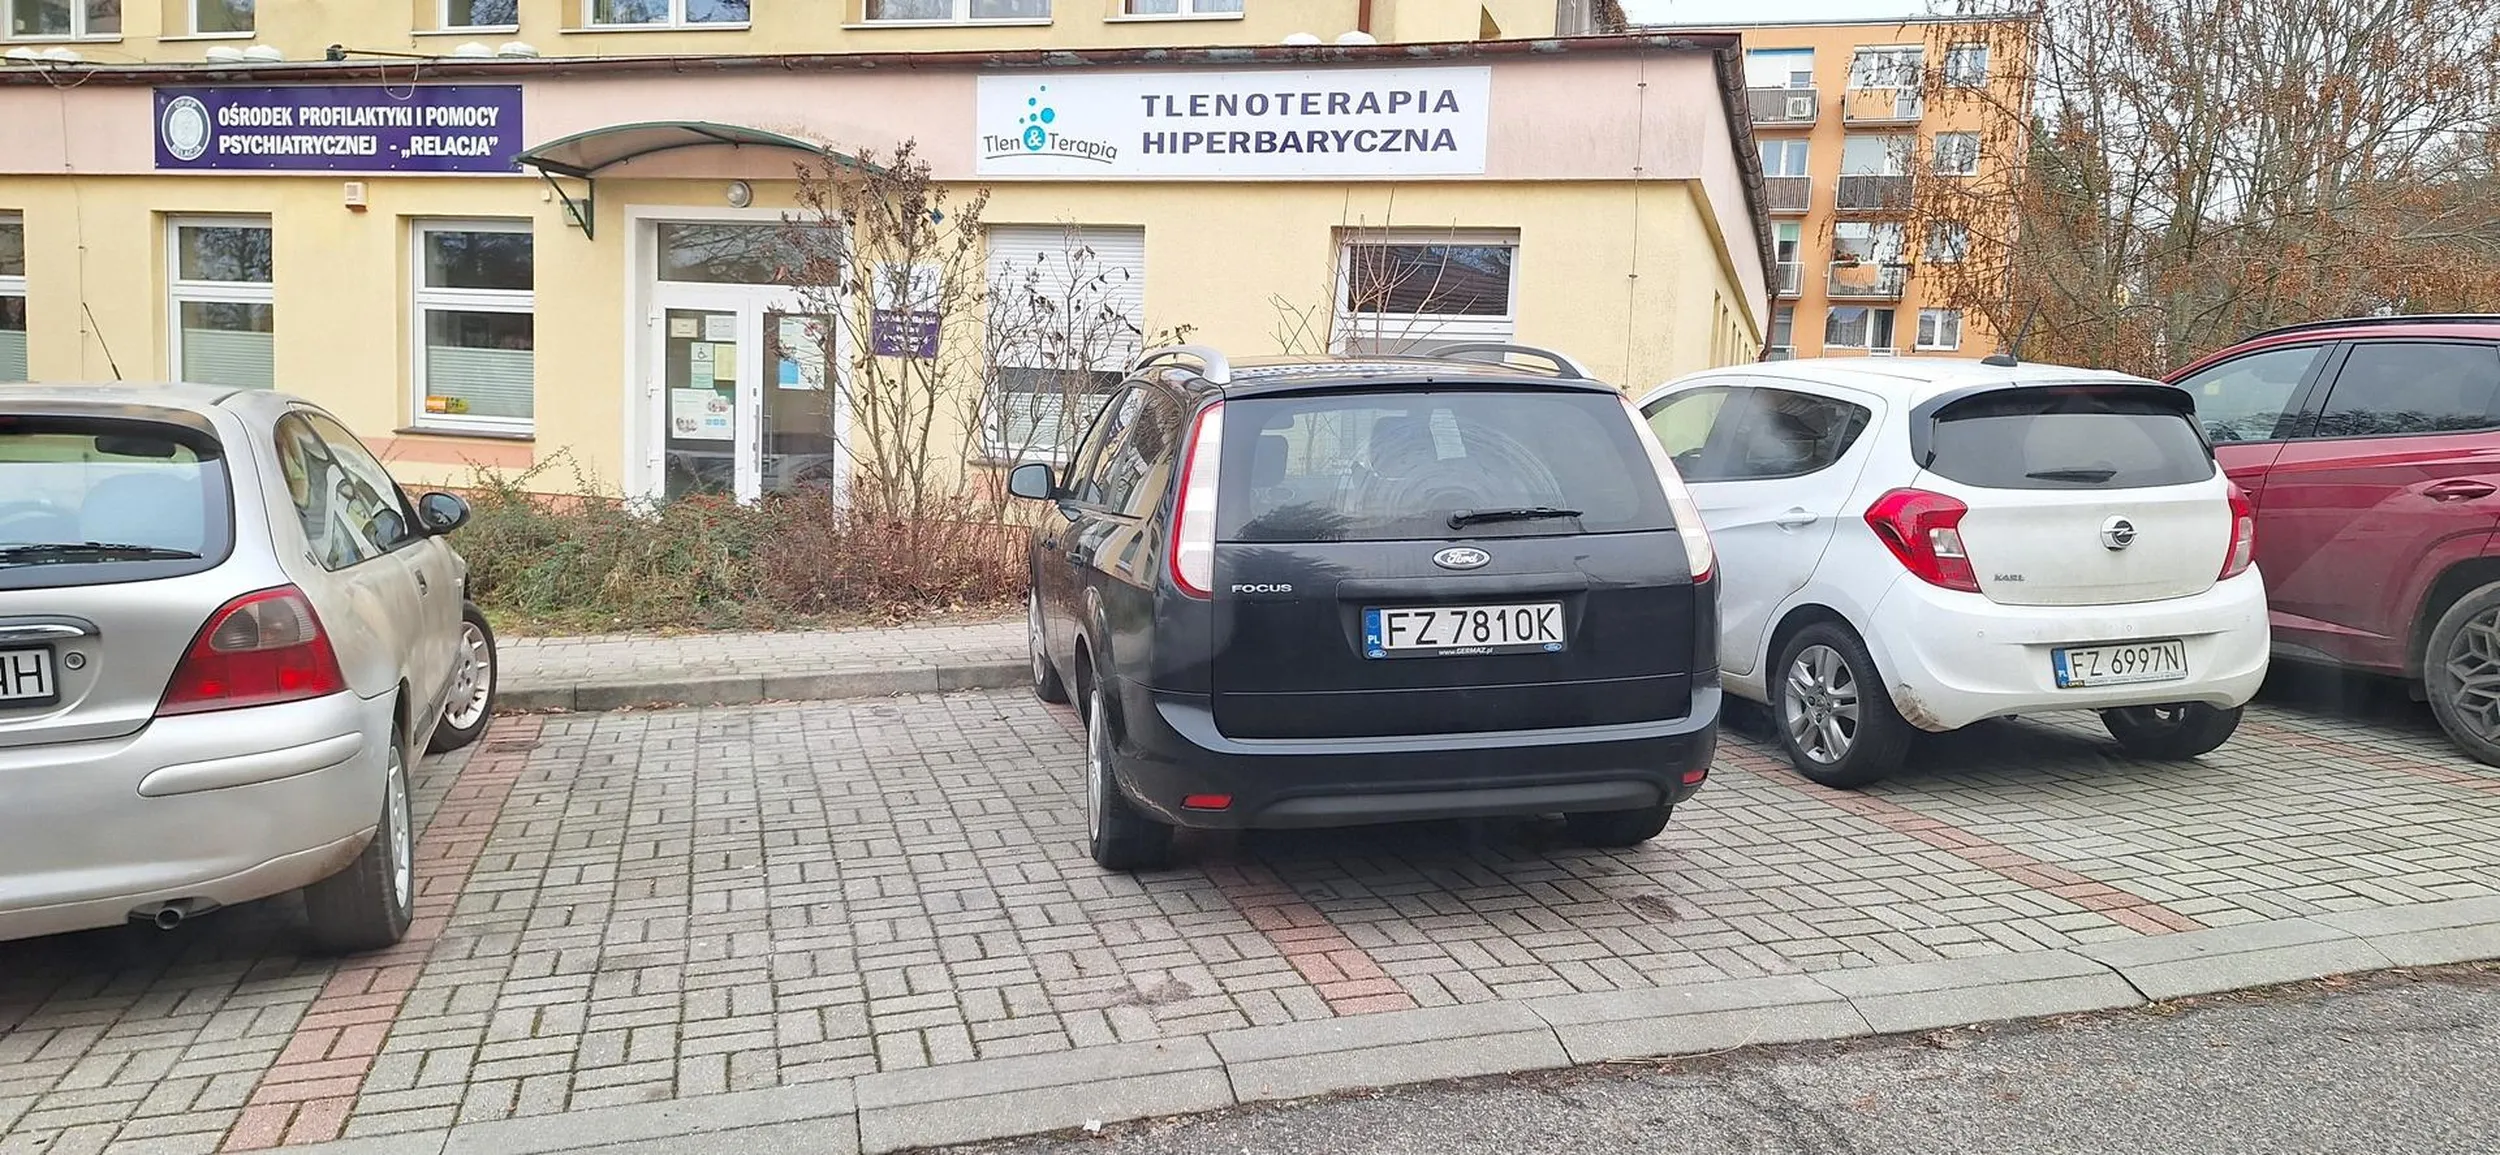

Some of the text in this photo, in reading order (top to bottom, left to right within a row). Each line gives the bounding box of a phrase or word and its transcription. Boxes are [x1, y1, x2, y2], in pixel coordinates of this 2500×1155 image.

[218, 102, 499, 126] OŚRODEK PROFILAKTYKI I POMOCY
[1141, 89, 1460, 117] TLENOTERAPIA
[219, 135, 377, 155] PSYCHIATRYCZNEJ
[983, 129, 1118, 160] Tlen & Terapia
[1143, 128, 1457, 154] HIPERBARYCZNA
[1447, 551, 1479, 564] Ford
[1231, 584, 1293, 593] FOCUS
[1368, 635, 1380, 644] PL
[1387, 607, 1558, 647] FZ 7810K
[2071, 651, 2103, 678] FZ
[2111, 645, 2180, 674] 6997N
